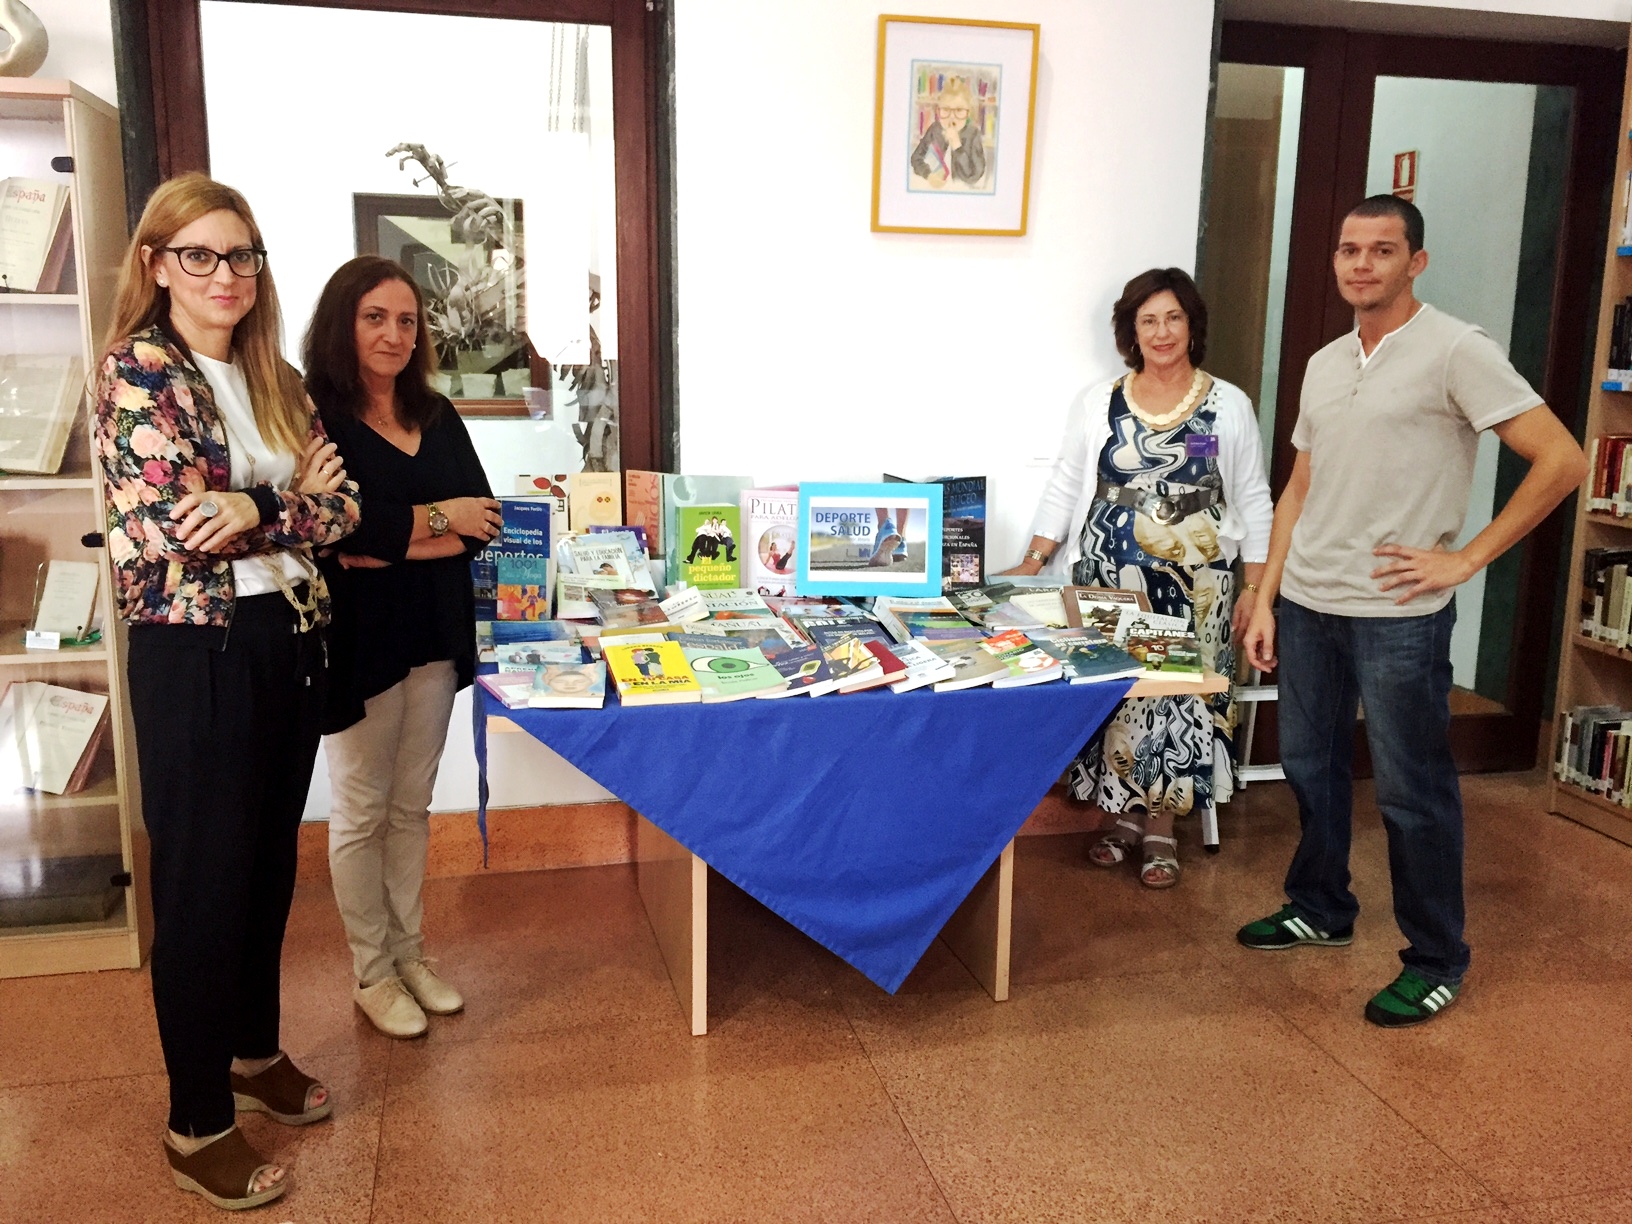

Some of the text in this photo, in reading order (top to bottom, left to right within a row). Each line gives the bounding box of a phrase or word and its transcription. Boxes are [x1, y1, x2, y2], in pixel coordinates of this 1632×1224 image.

[815, 512, 871, 524] DEPORTE
[503, 526, 543, 537] Enciclopedia
[830, 525, 871, 537] SALUD
[503, 537, 543, 546] visual de los
[510, 559, 538, 569] 1001
[701, 556, 712, 565] El
[688, 563, 732, 575] pequeño
[693, 573, 737, 582] dictador
[1129, 628, 1196, 639] CAPITANES
